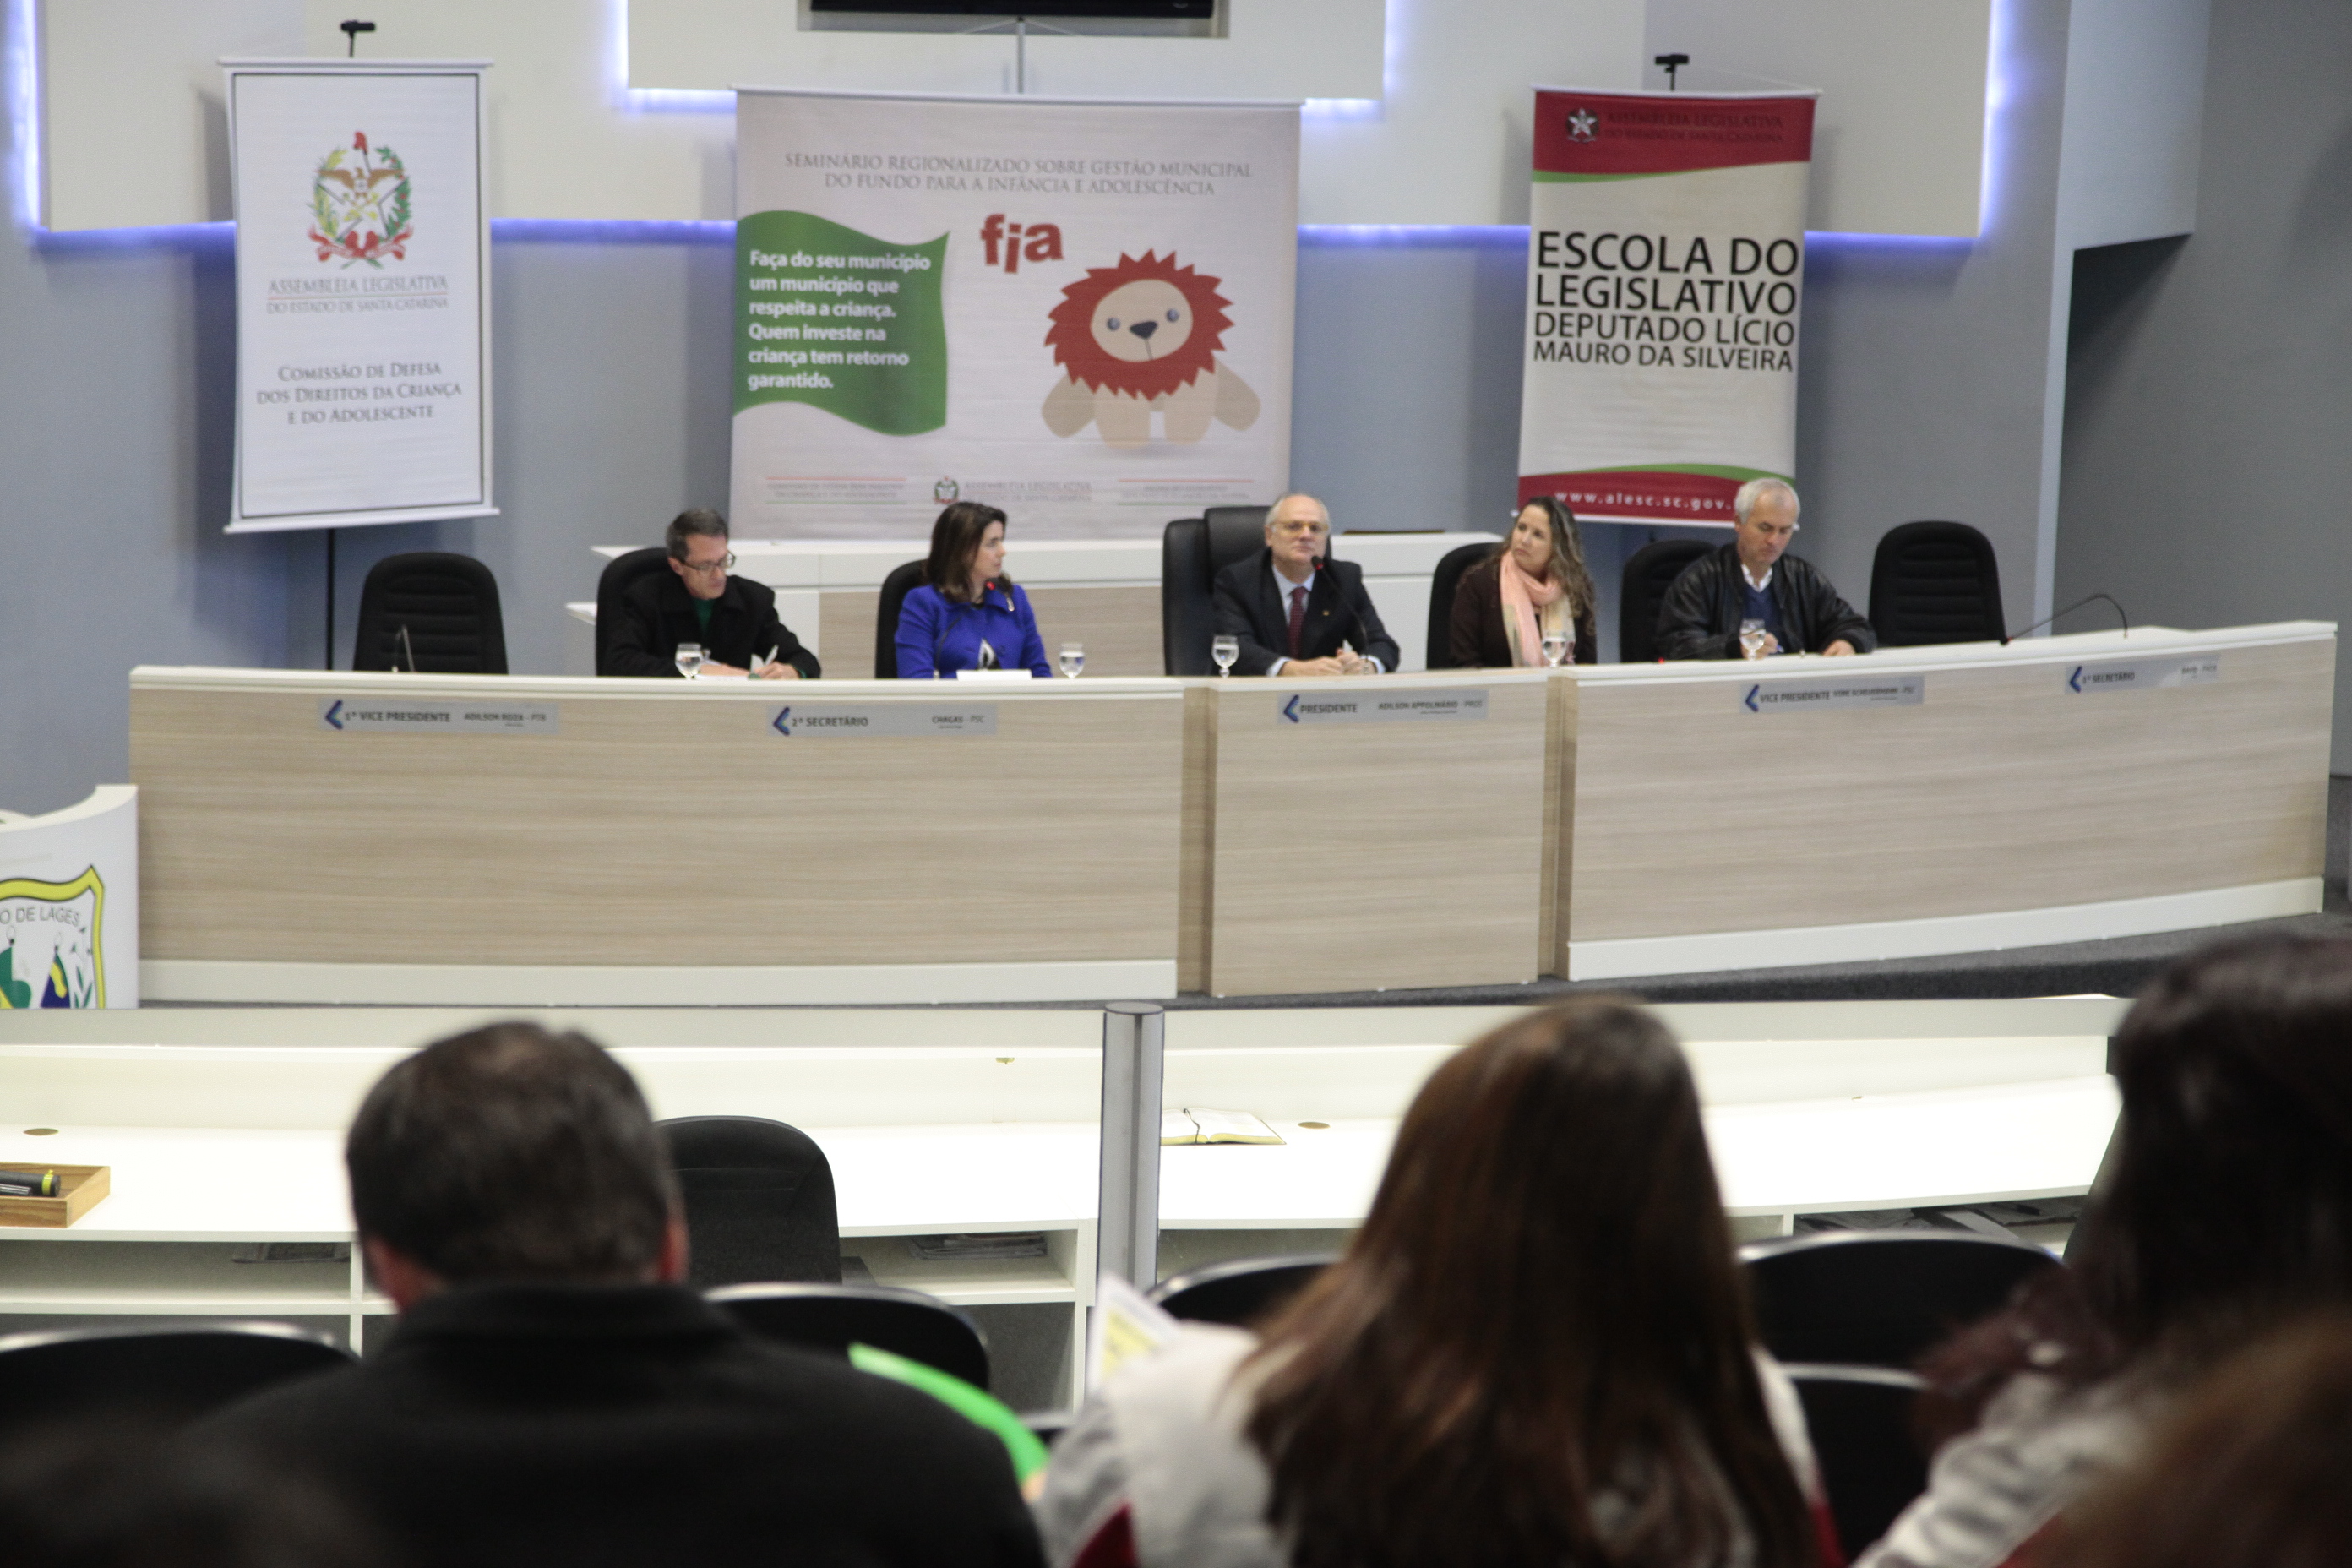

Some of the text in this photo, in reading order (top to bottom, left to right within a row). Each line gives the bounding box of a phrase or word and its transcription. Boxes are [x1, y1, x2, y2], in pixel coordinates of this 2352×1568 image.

[888, 155, 1030, 174] REGIONALIZADO
[1035, 159, 1084, 174] SOBRE
[1090, 159, 1156, 176] GESTÃO
[1160, 161, 1251, 177] MUNICIPAL
[825, 172, 852, 188] DO
[858, 173, 921, 190] FUNDO
[926, 174, 967, 191] PARA
[970, 176, 983, 191] A
[1075, 178, 1083, 193] E
[1088, 177, 1215, 195] ADOLESCÊNCIA
[749, 250, 787, 271] Faça
[790, 251, 814, 268] do
[816, 254, 845, 269] seu
[1538, 231, 1799, 276] ESCOLA DO
[268, 275, 449, 295] ASSEMBLEIA LEGISLATIVA
[749, 277, 777, 291] um
[866, 280, 899, 297] que
[1535, 274, 1798, 316] LEGISLATIVO
[749, 299, 897, 321] respeita a criança.
[749, 322, 886, 341] Quem investe na
[1534, 312, 1795, 348] DEPUTADO LÍCIO
[748, 347, 910, 368] criança tem retorno
[1533, 340, 1794, 372] MAURO DA SILVEIRA
[748, 372, 834, 391] garantido.
[1760, 690, 1830, 703] VICE PRESIDENTE
[359, 711, 383, 721] VICE
[386, 711, 451, 723] PRESIDENTE
[1300, 704, 1358, 714] PRESIDENTE
[806, 716, 869, 727] SECRETÁRIO
[16, 906, 35, 923] DE
[40, 906, 80, 927] LAGES
